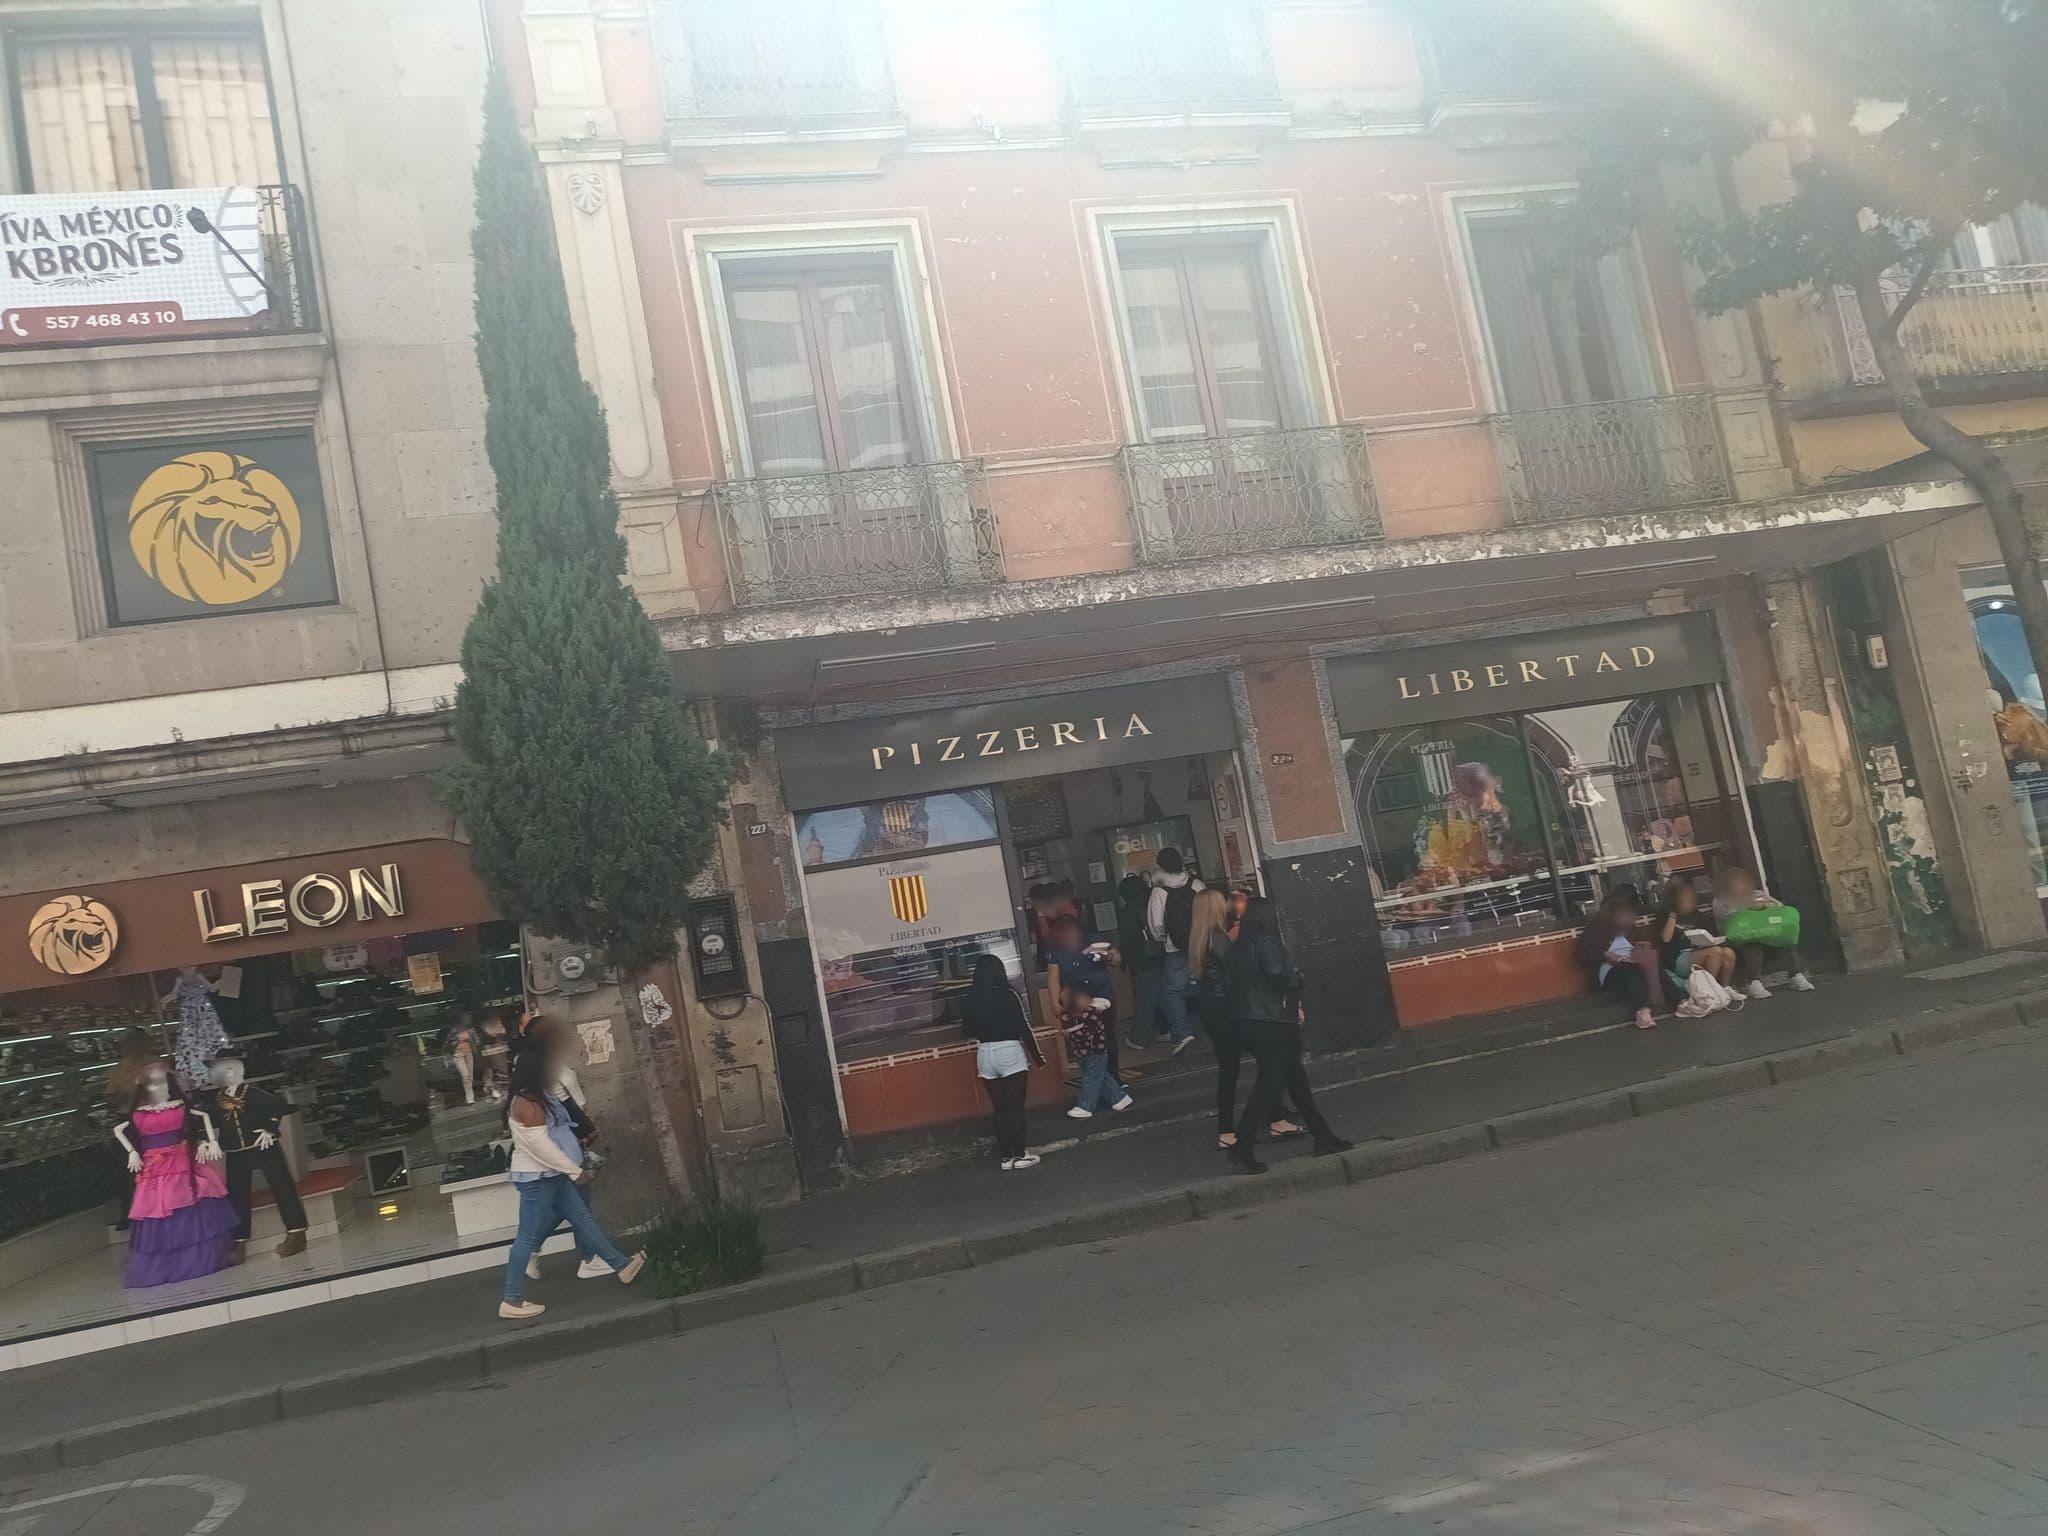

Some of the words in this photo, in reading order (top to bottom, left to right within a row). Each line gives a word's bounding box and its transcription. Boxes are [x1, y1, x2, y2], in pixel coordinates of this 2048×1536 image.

[0, 211, 57, 244] IVA
[59, 204, 173, 239] MÉXICO
[6, 232, 184, 281] KBRONES
[46, 315, 79, 329] 557
[86, 314, 121, 327] 468
[128, 312, 150, 325] 43
[154, 310, 176, 323] 10
[1397, 645, 1656, 699] LIBERTAD
[871, 713, 1154, 770] PIZZERIA
[750, 824, 766, 834] 227
[192, 863, 404, 944] LEON
[889, 925, 942, 943] LIBERTAD
